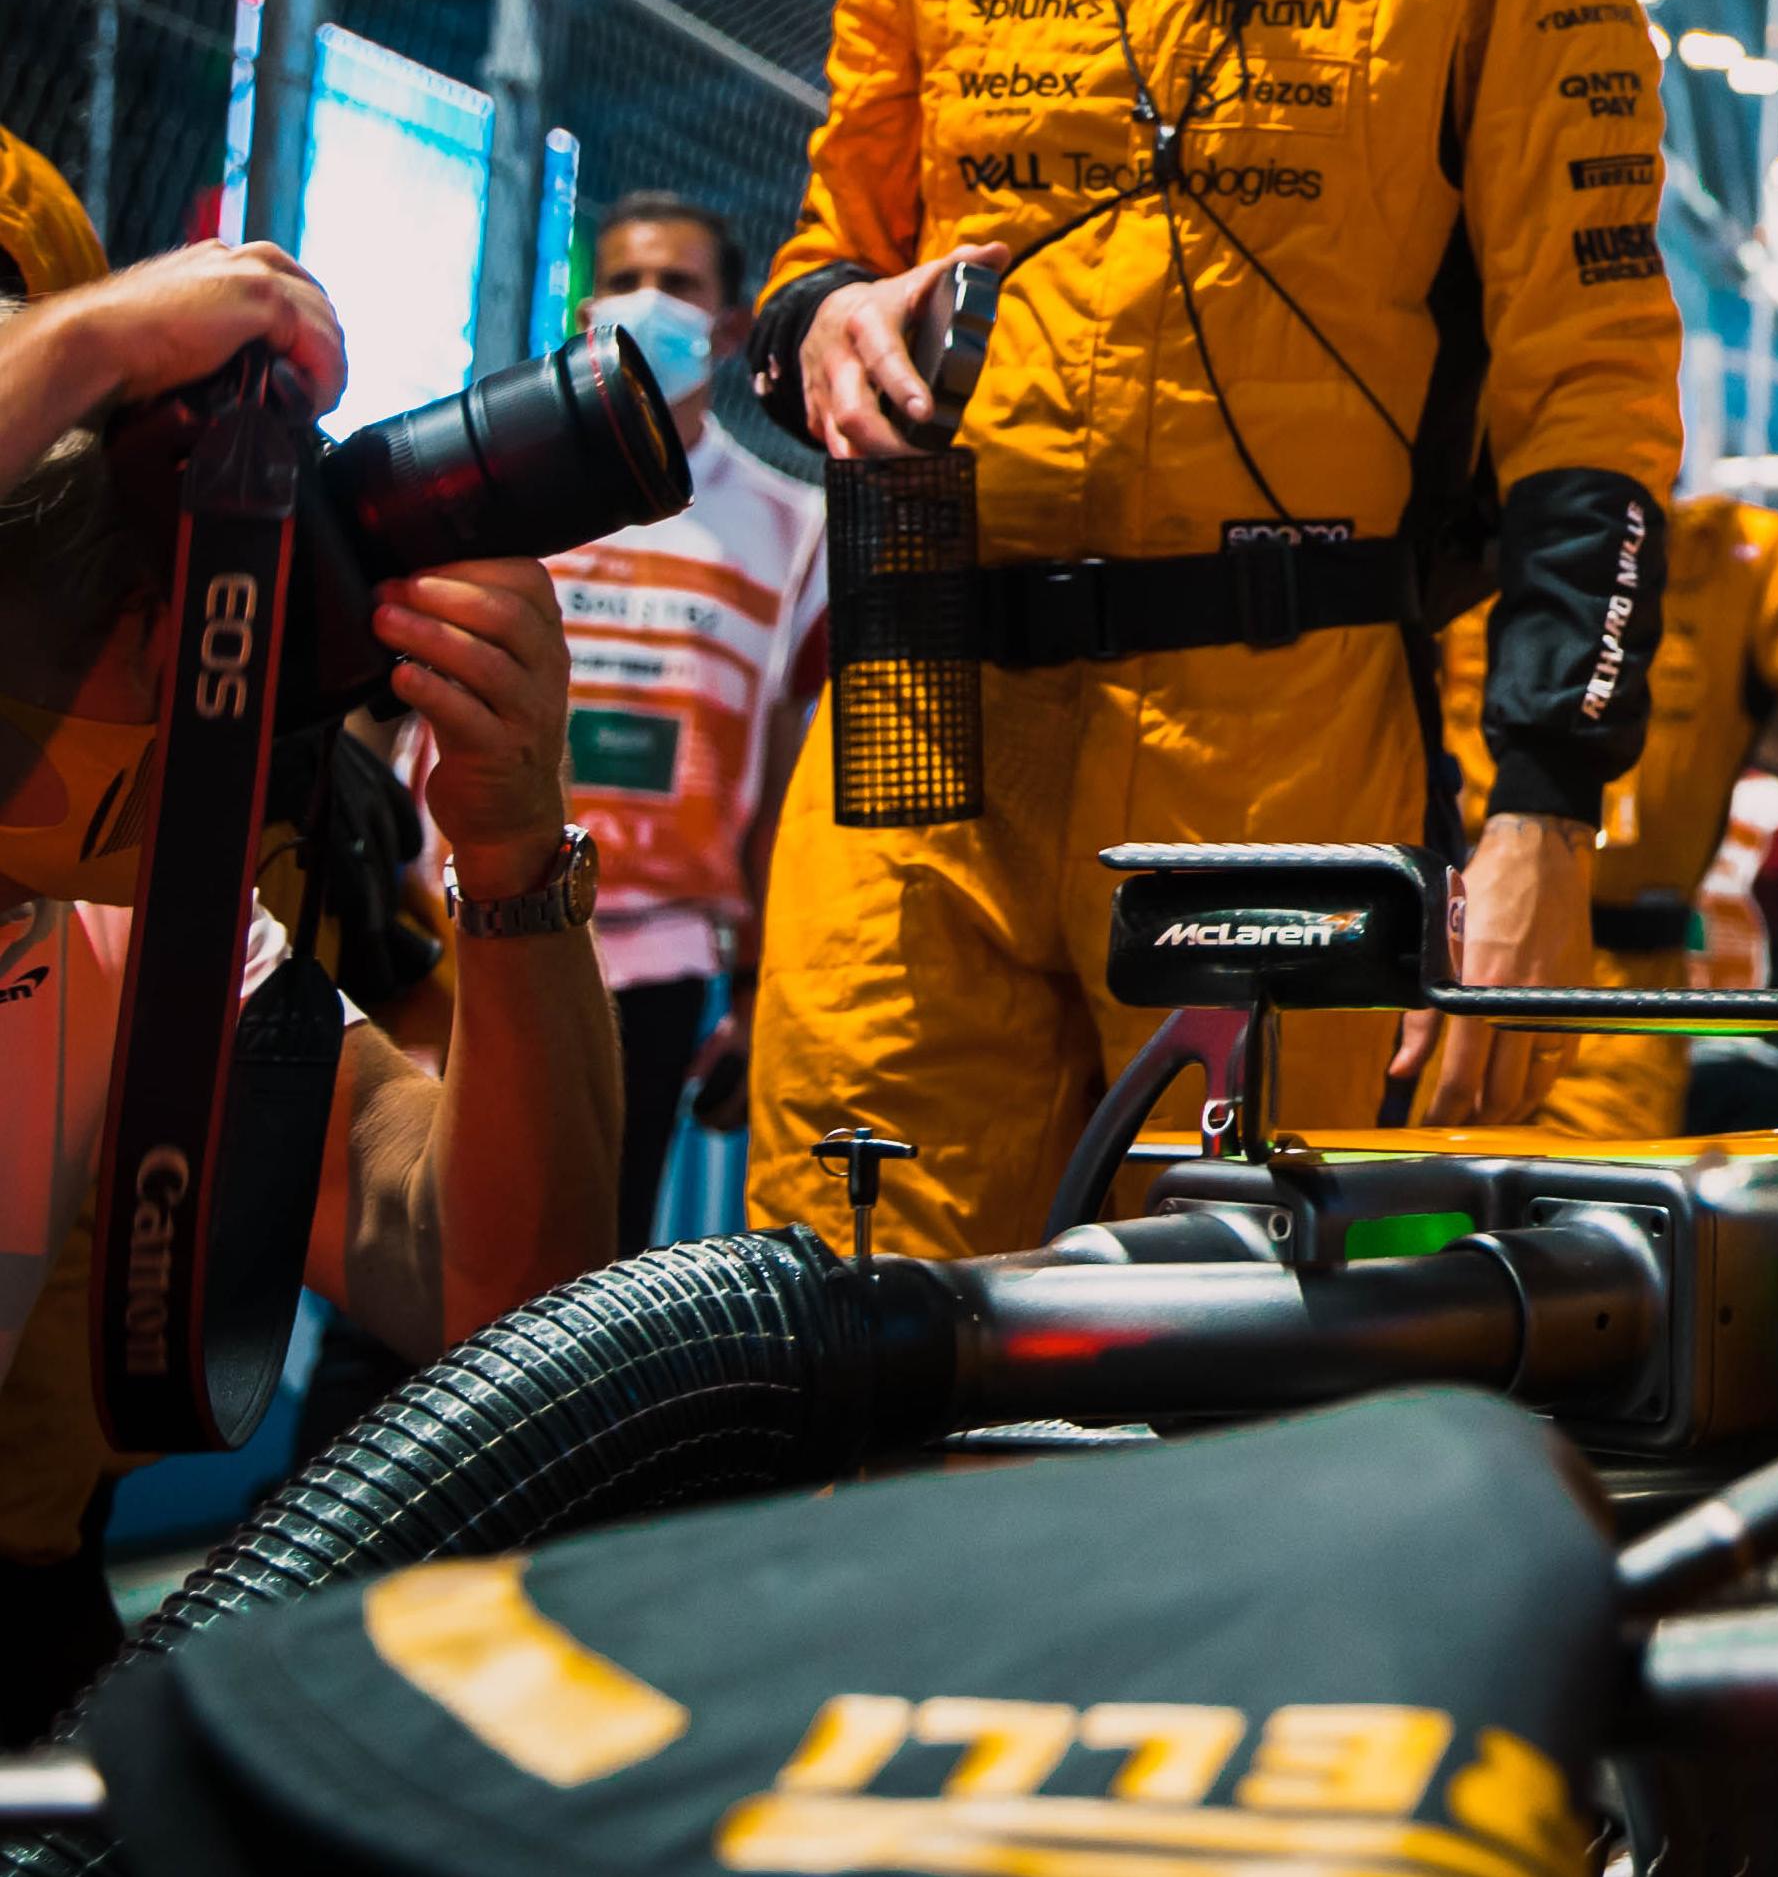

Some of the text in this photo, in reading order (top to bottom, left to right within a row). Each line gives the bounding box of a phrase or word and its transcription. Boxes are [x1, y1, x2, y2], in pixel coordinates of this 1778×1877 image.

[959, 63, 1084, 99] webex
[1234, 73, 1334, 108] Tezos
[957, 152, 1051, 192] DELL
[196, 572, 258, 719] EOS
[1153, 922, 1338, 947] McLaren
